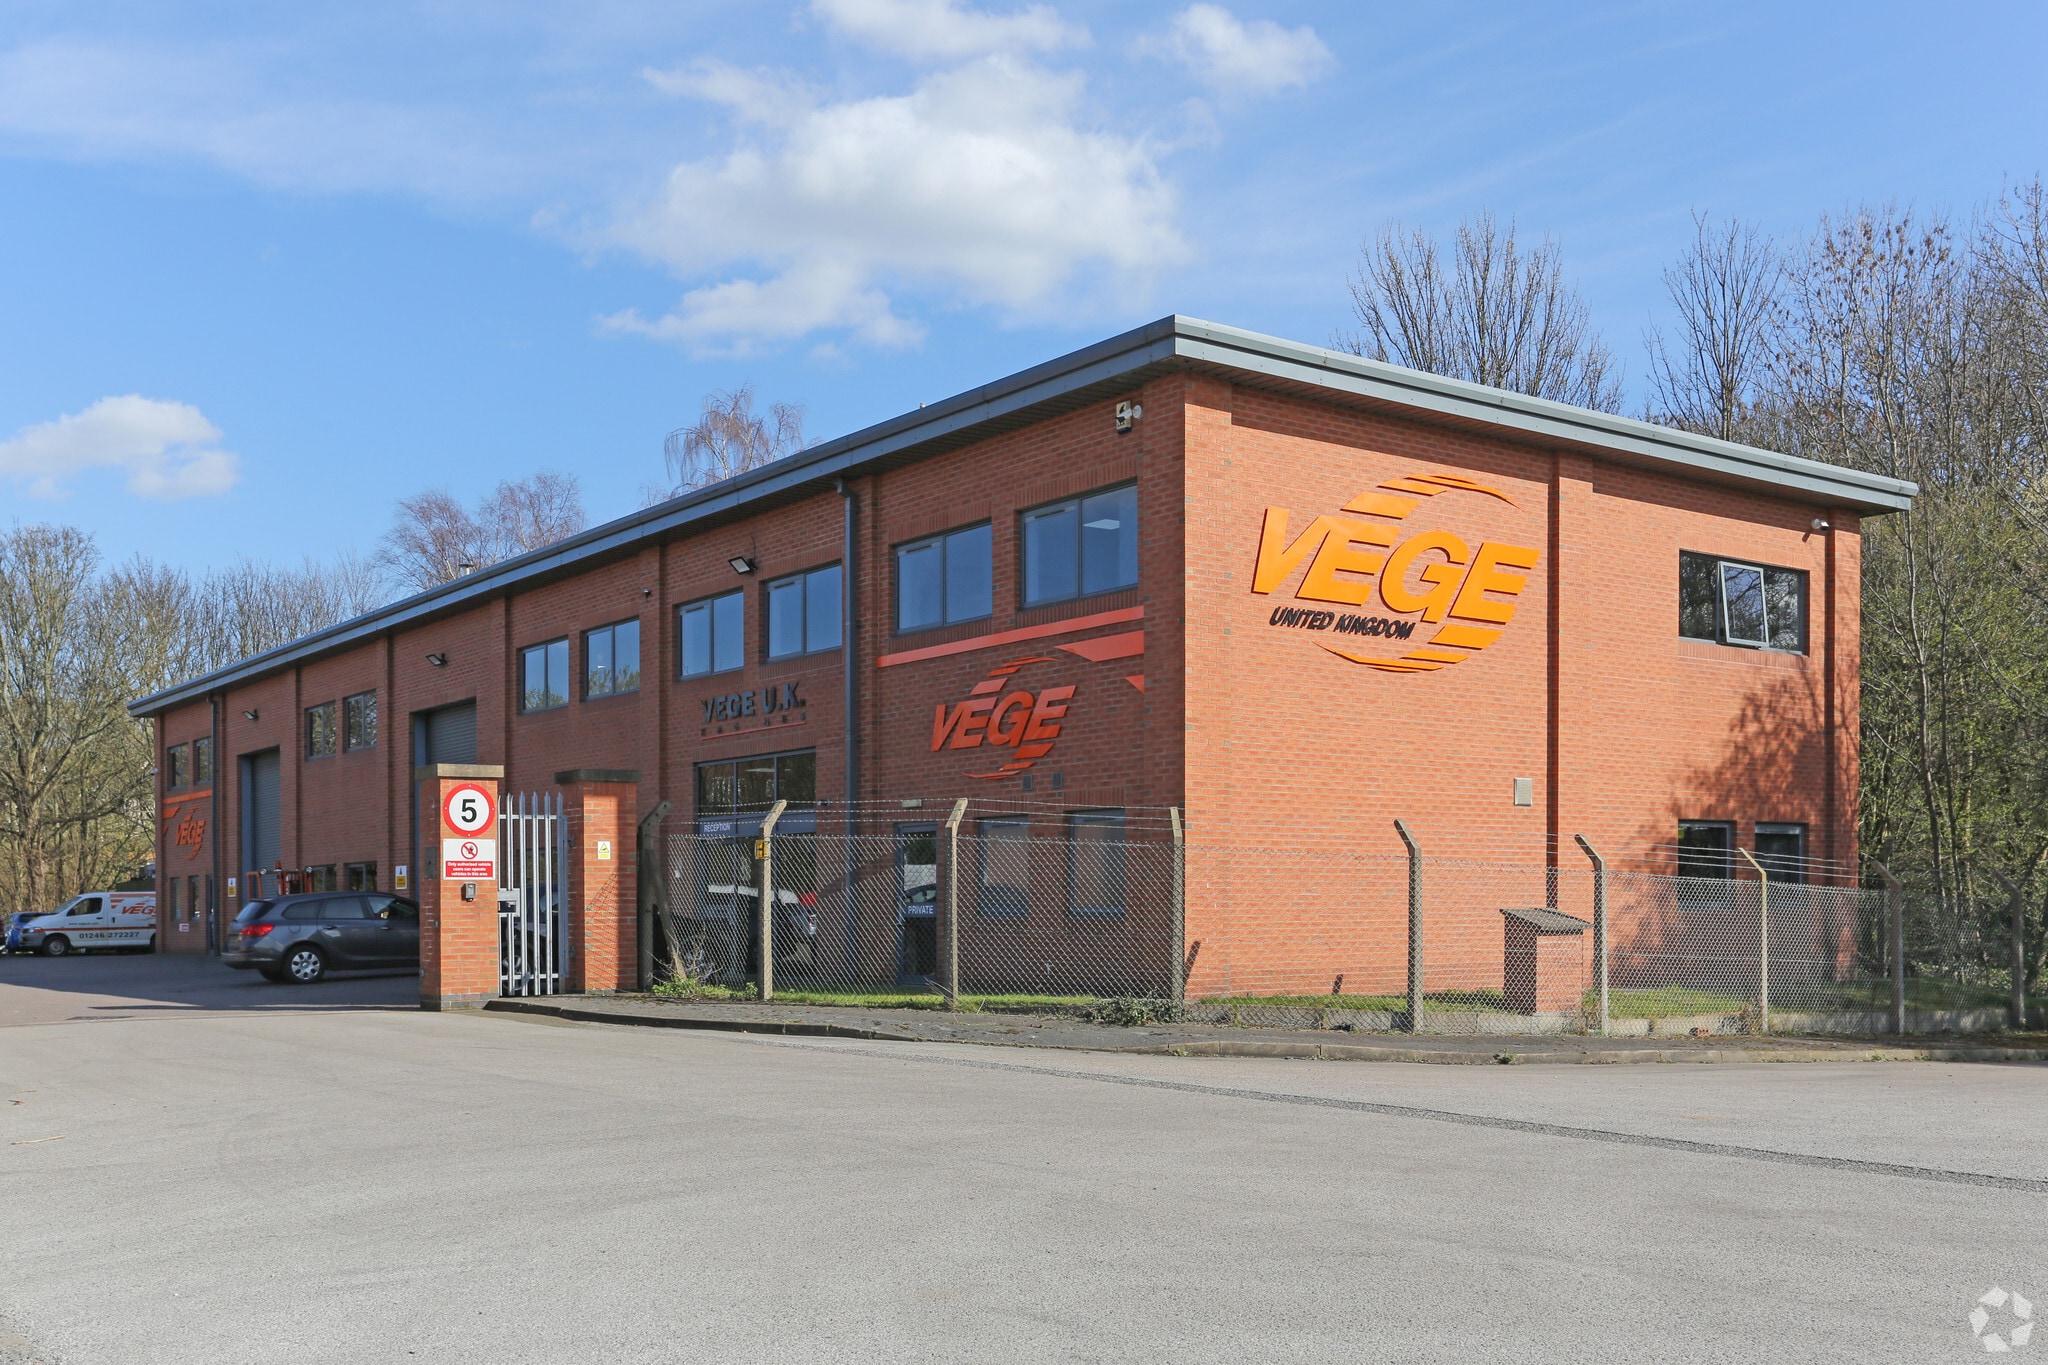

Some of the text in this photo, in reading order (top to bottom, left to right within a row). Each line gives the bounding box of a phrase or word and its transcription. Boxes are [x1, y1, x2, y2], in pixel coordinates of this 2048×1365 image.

[1251, 507, 1541, 625] VEGE
[1269, 606, 1416, 641] UNITED KINGDOM
[701, 681, 806, 723] VEGE U.K.
[931, 685, 1077, 752] VEGE
[461, 798, 477, 823] 5
[176, 820, 206, 846] VEGE
[703, 822, 731, 833] RECEPTION
[122, 905, 157, 915] VEG
[907, 905, 934, 915] PRIVATE
